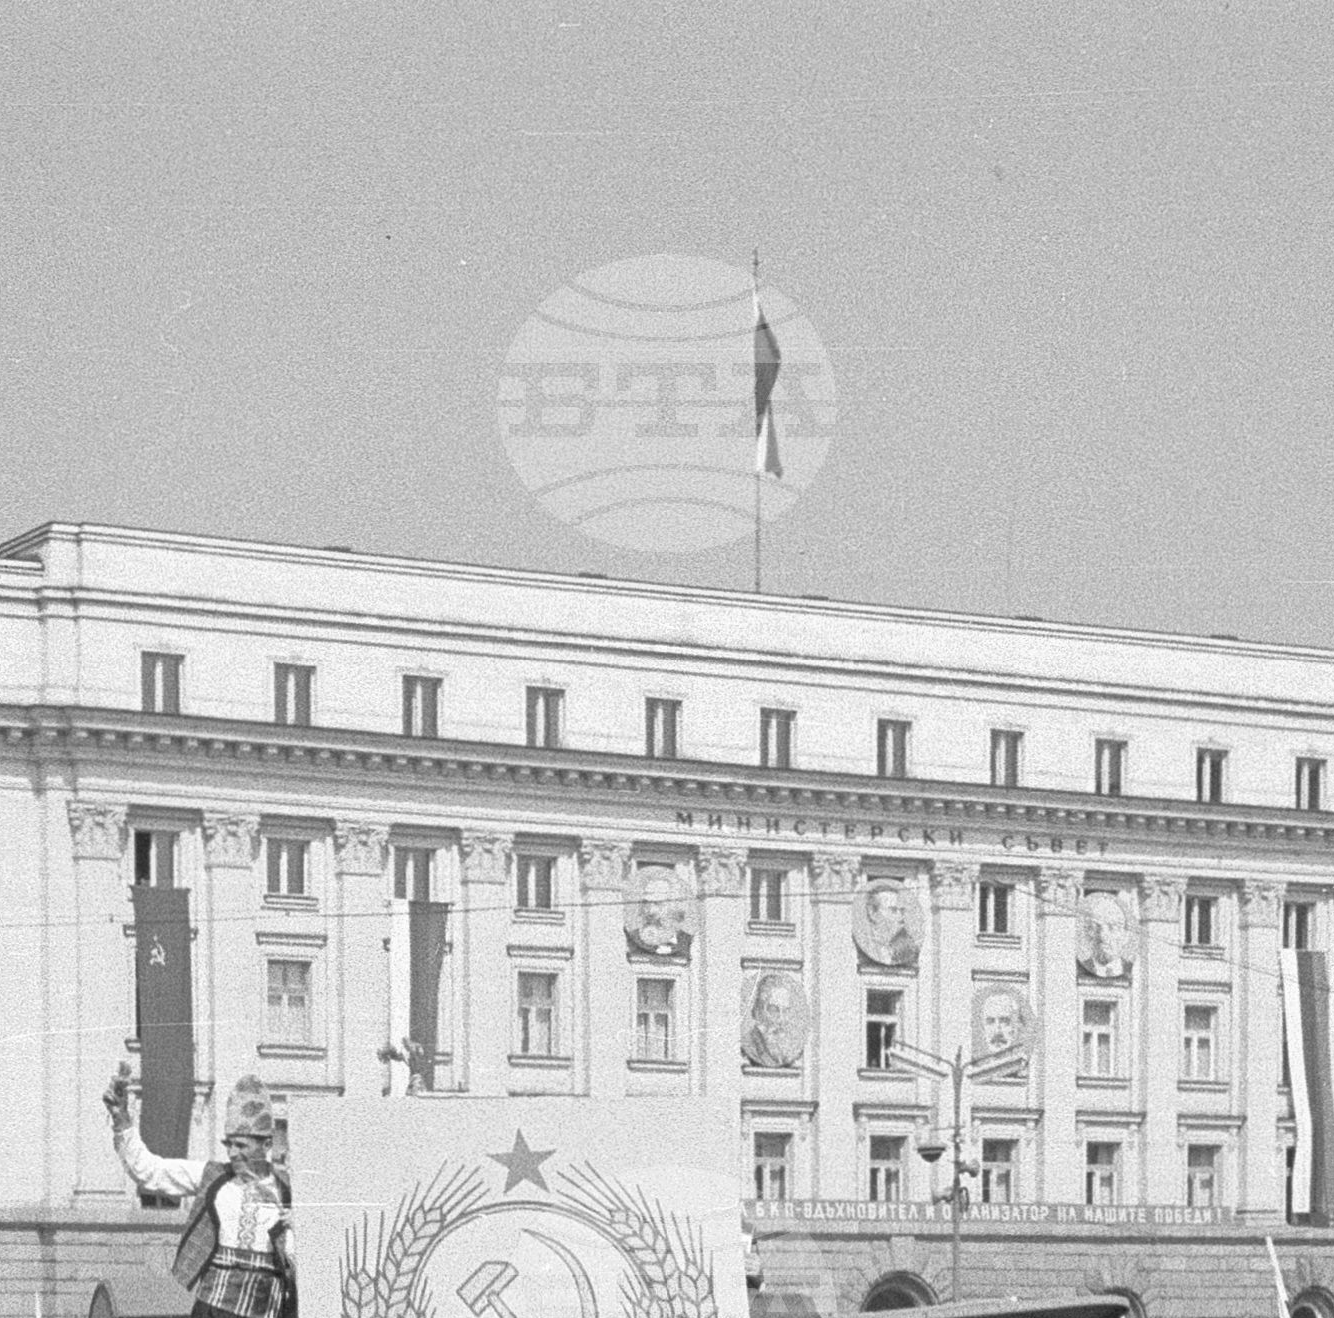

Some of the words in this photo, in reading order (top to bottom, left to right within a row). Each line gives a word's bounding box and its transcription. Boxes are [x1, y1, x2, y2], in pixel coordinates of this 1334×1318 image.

[674, 811, 964, 845] МИНИСТЕРСКИ
[1002, 835, 1110, 857] СЪВЕТ
[942, 1203, 1049, 1222] ОАНИЗАТОР
[1058, 1206, 1077, 1222] НА
[1085, 1207, 1147, 1223] НАШИТЕ
